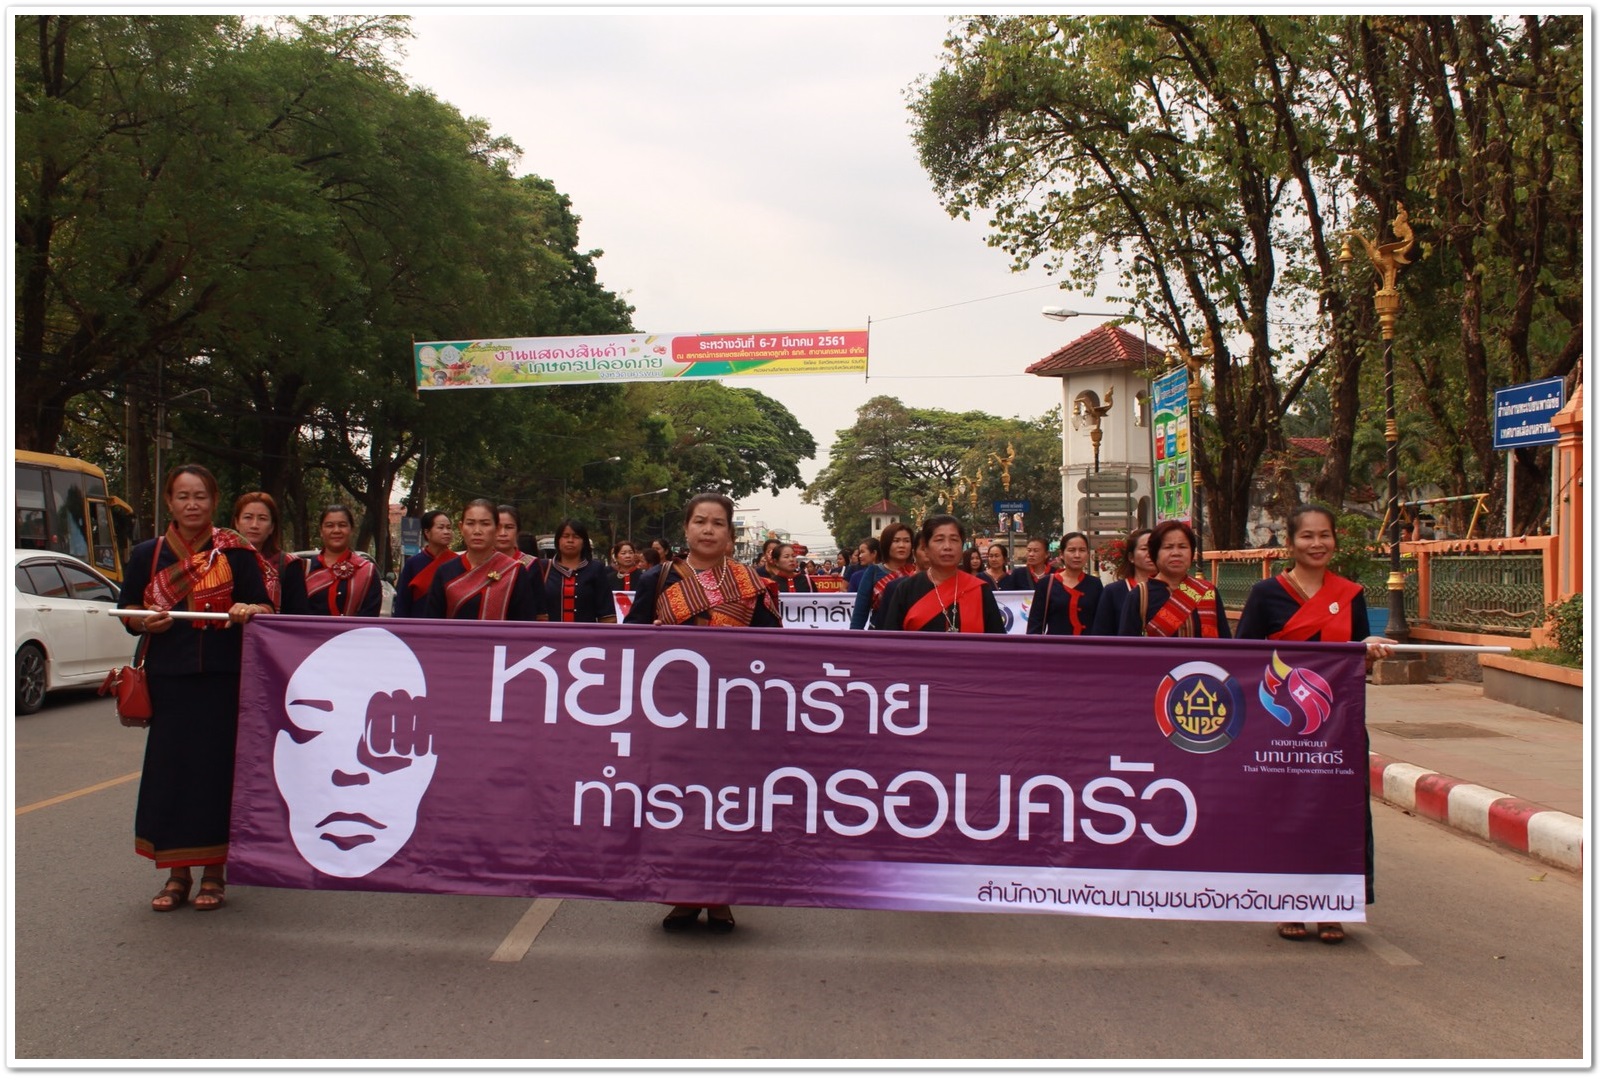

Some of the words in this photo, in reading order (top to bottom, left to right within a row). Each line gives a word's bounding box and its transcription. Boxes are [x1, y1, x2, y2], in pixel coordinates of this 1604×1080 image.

[700, 335, 755, 350] ระหว่างวันที่
[759, 338, 777, 348] 6-7
[781, 336, 814, 347] มีนาคม
[818, 336, 845, 346] 2561
[495, 343, 626, 361] งานแสดงสินค้า
[529, 355, 663, 374] เกษตรปลอดภัย
[489, 646, 930, 757] หยุดทำร้าย
[1271, 739, 1328, 749] กองทุนพัฒนา
[1255, 750, 1344, 764] บทบาทสตรี
[1287, 767, 1334, 775] Empowerment
[573, 755, 1198, 847] ทำรายครอบครัว
[977, 881, 1355, 913] สำนักงานพัฒนาชุมชนจังหวัดนครพนม
